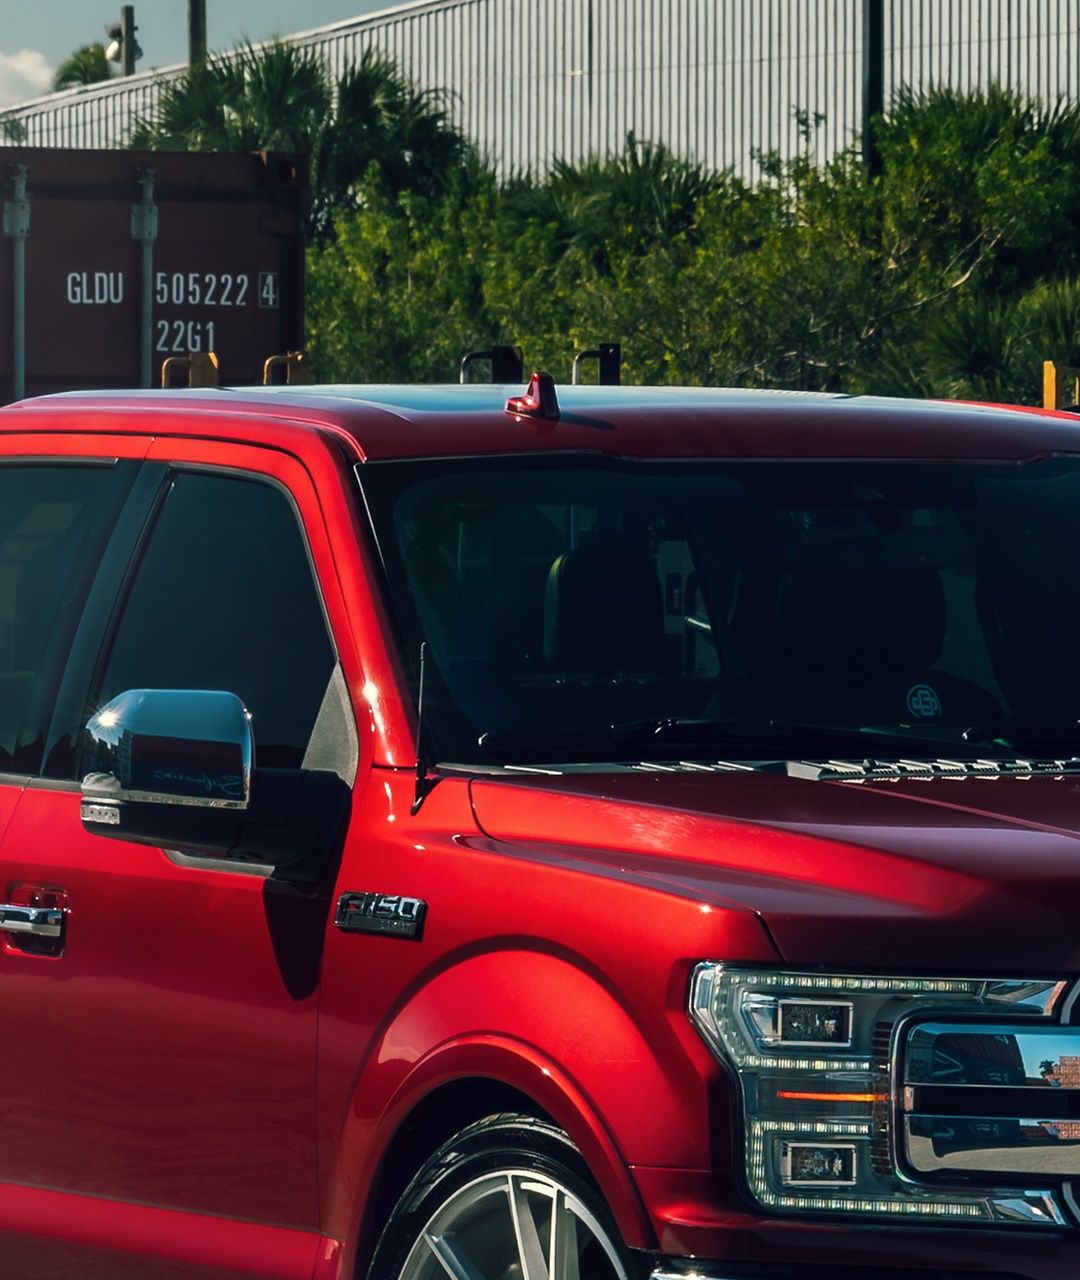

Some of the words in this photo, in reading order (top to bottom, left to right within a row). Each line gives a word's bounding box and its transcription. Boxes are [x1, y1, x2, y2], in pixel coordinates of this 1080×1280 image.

[67, 272, 124, 304] GLDU
[156, 273, 249, 306] 505222
[262, 275, 277, 306] 4
[156, 320, 215, 352] 22G1
